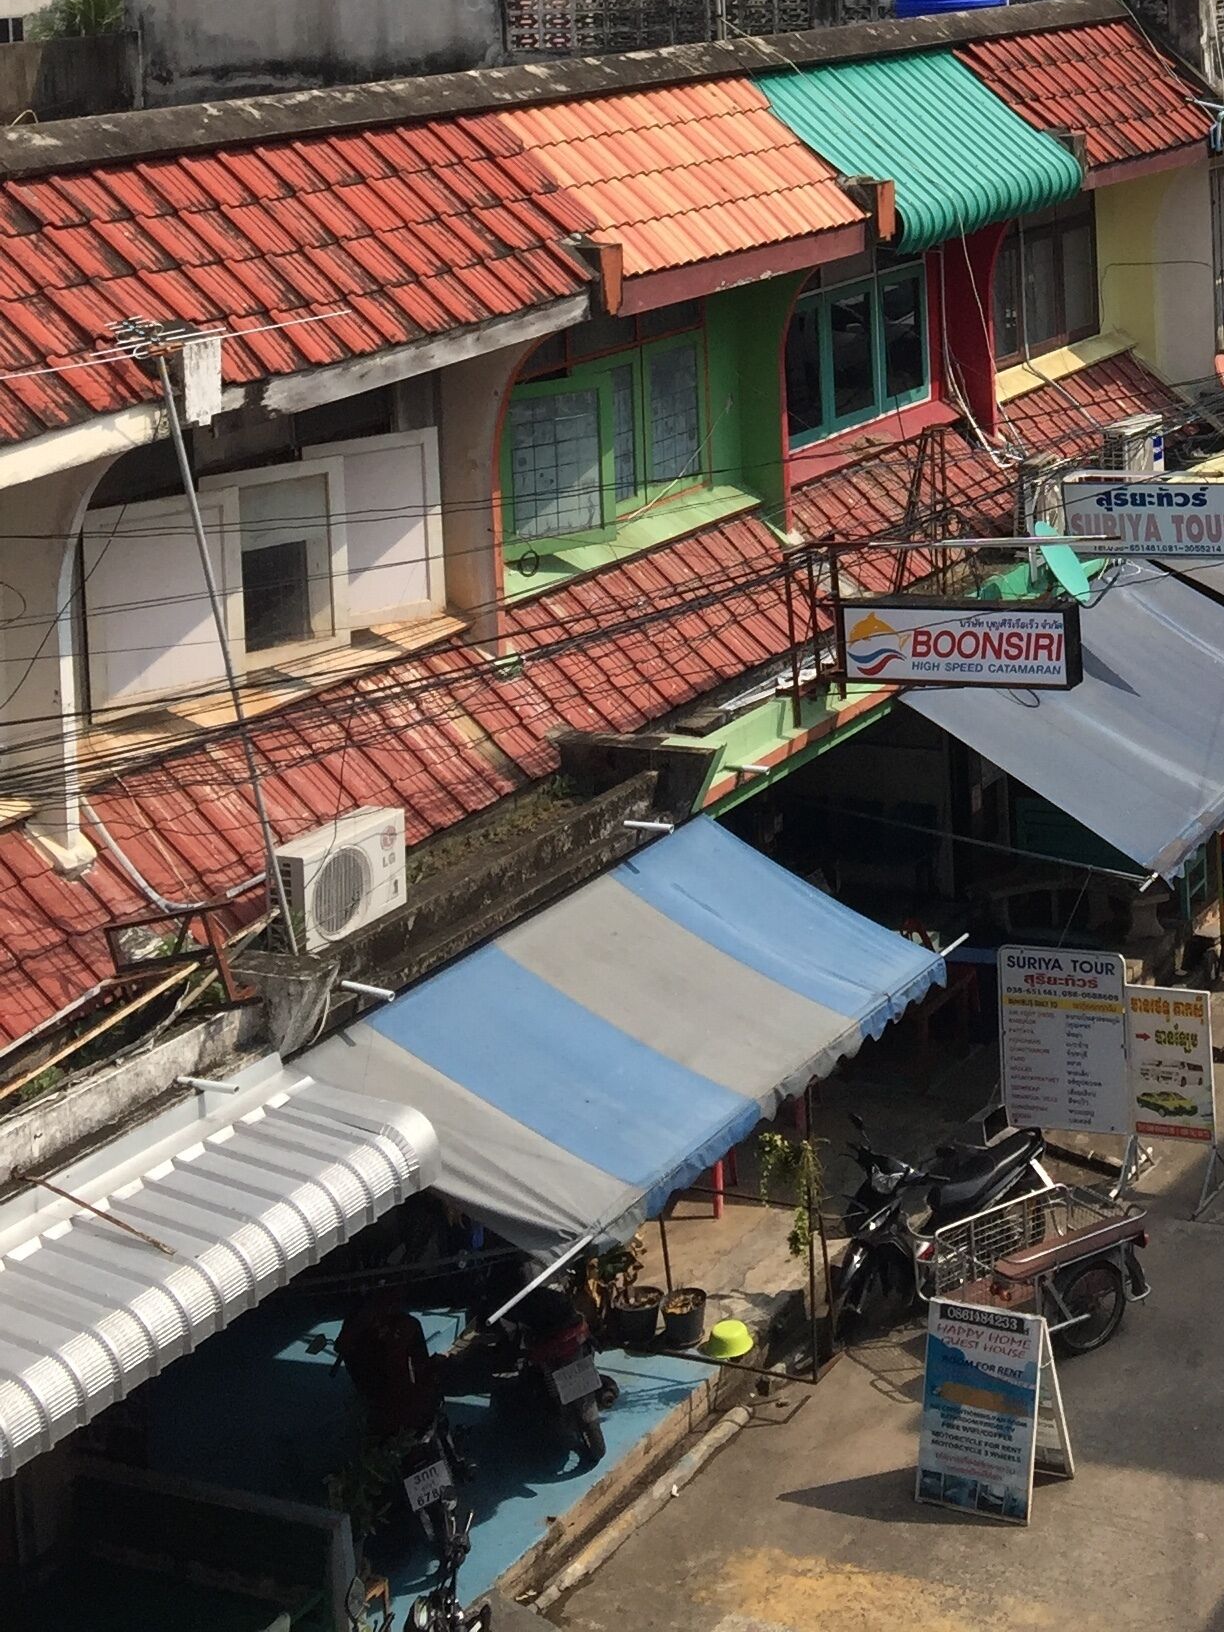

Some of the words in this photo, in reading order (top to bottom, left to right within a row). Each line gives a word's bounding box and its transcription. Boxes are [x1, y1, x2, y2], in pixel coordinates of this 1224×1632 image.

[1071, 512, 1163, 543] SURIYA
[911, 629, 1063, 662] BOONSIRI
[912, 661, 940, 672] HIGH
[944, 662, 984, 673] SPEED
[988, 663, 1061, 675] CATAMARAN
[1007, 955, 1063, 971] SURIYA
[1071, 959, 1115, 976] TOUR
[937, 1323, 984, 1339] HAPPY
[988, 1332, 1032, 1350] HOME
[942, 1335, 979, 1349] GUEST
[983, 1344, 1026, 1359] HOUSE
[997, 1366, 1024, 1379] RENT
